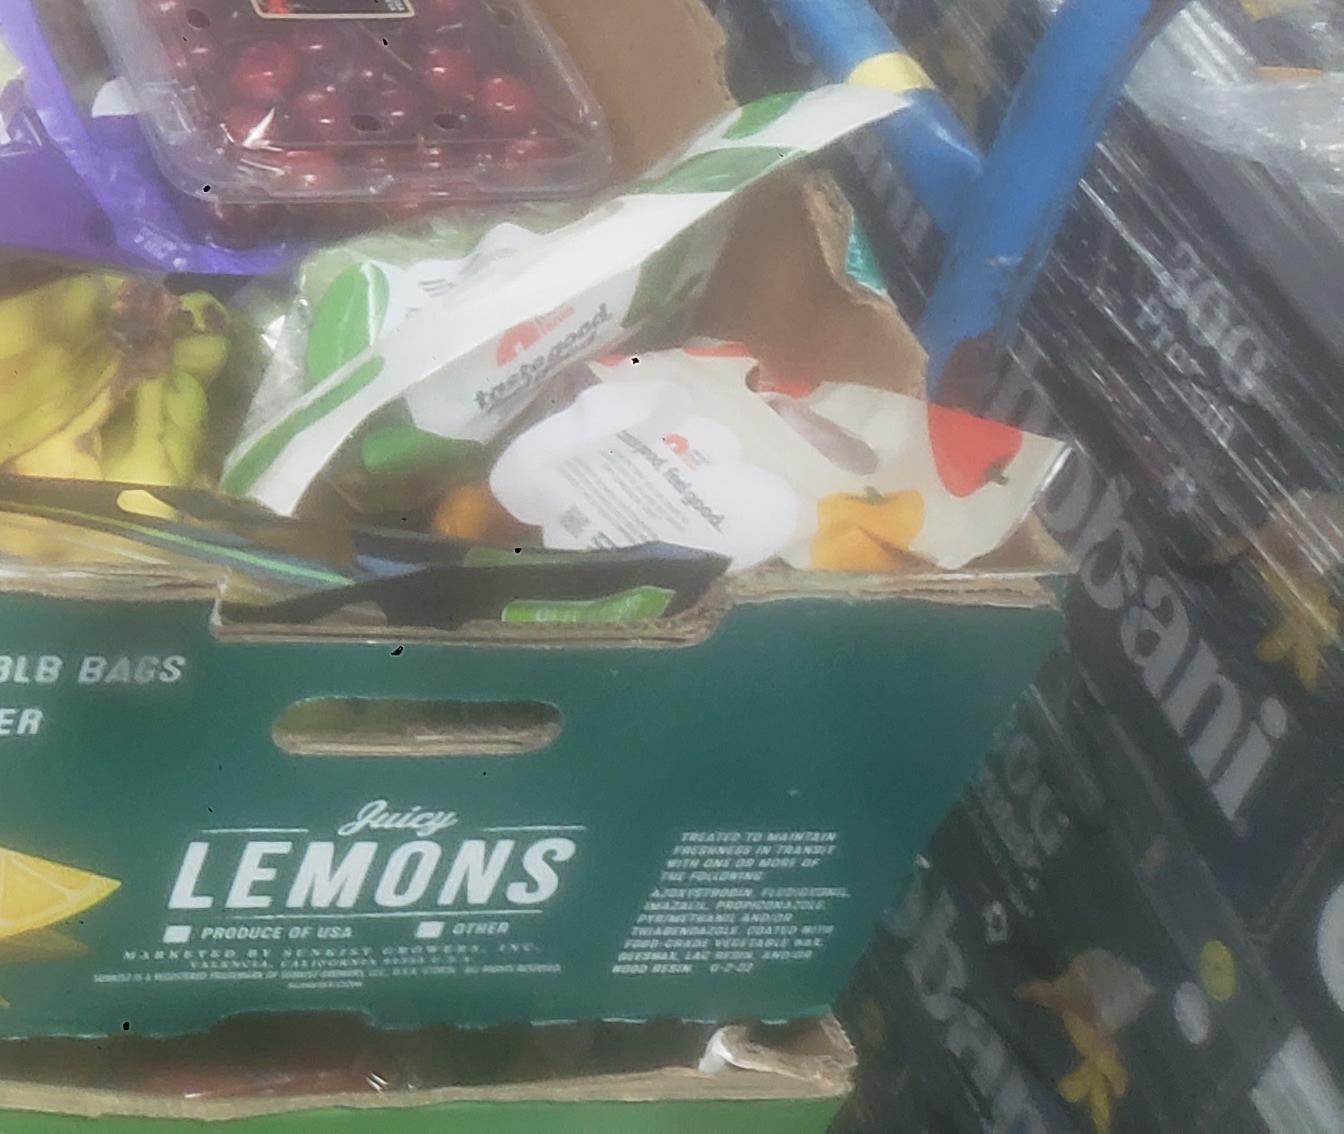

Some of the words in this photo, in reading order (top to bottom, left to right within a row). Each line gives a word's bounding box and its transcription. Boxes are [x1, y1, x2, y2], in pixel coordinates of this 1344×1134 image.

[77, 654, 187, 684] BAGS
[337, 798, 458, 837] Juicy
[681, 832, 741, 843] TREATED
[746, 832, 763, 843] TO
[767, 832, 837, 842] MAINTAIN
[672, 845, 753, 856] FRESHNESS
[756, 845, 772, 856] IN
[776, 845, 837, 855] TRANSIT
[666, 858, 699, 869] WITH
[800, 857, 820, 867] OF
[167, 836, 579, 911] LEMONS
[200, 926, 284, 941] PRODUCE
[288, 926, 311, 940] OF
[316, 925, 353, 940] USA
[451, 921, 511, 935] OTHER
